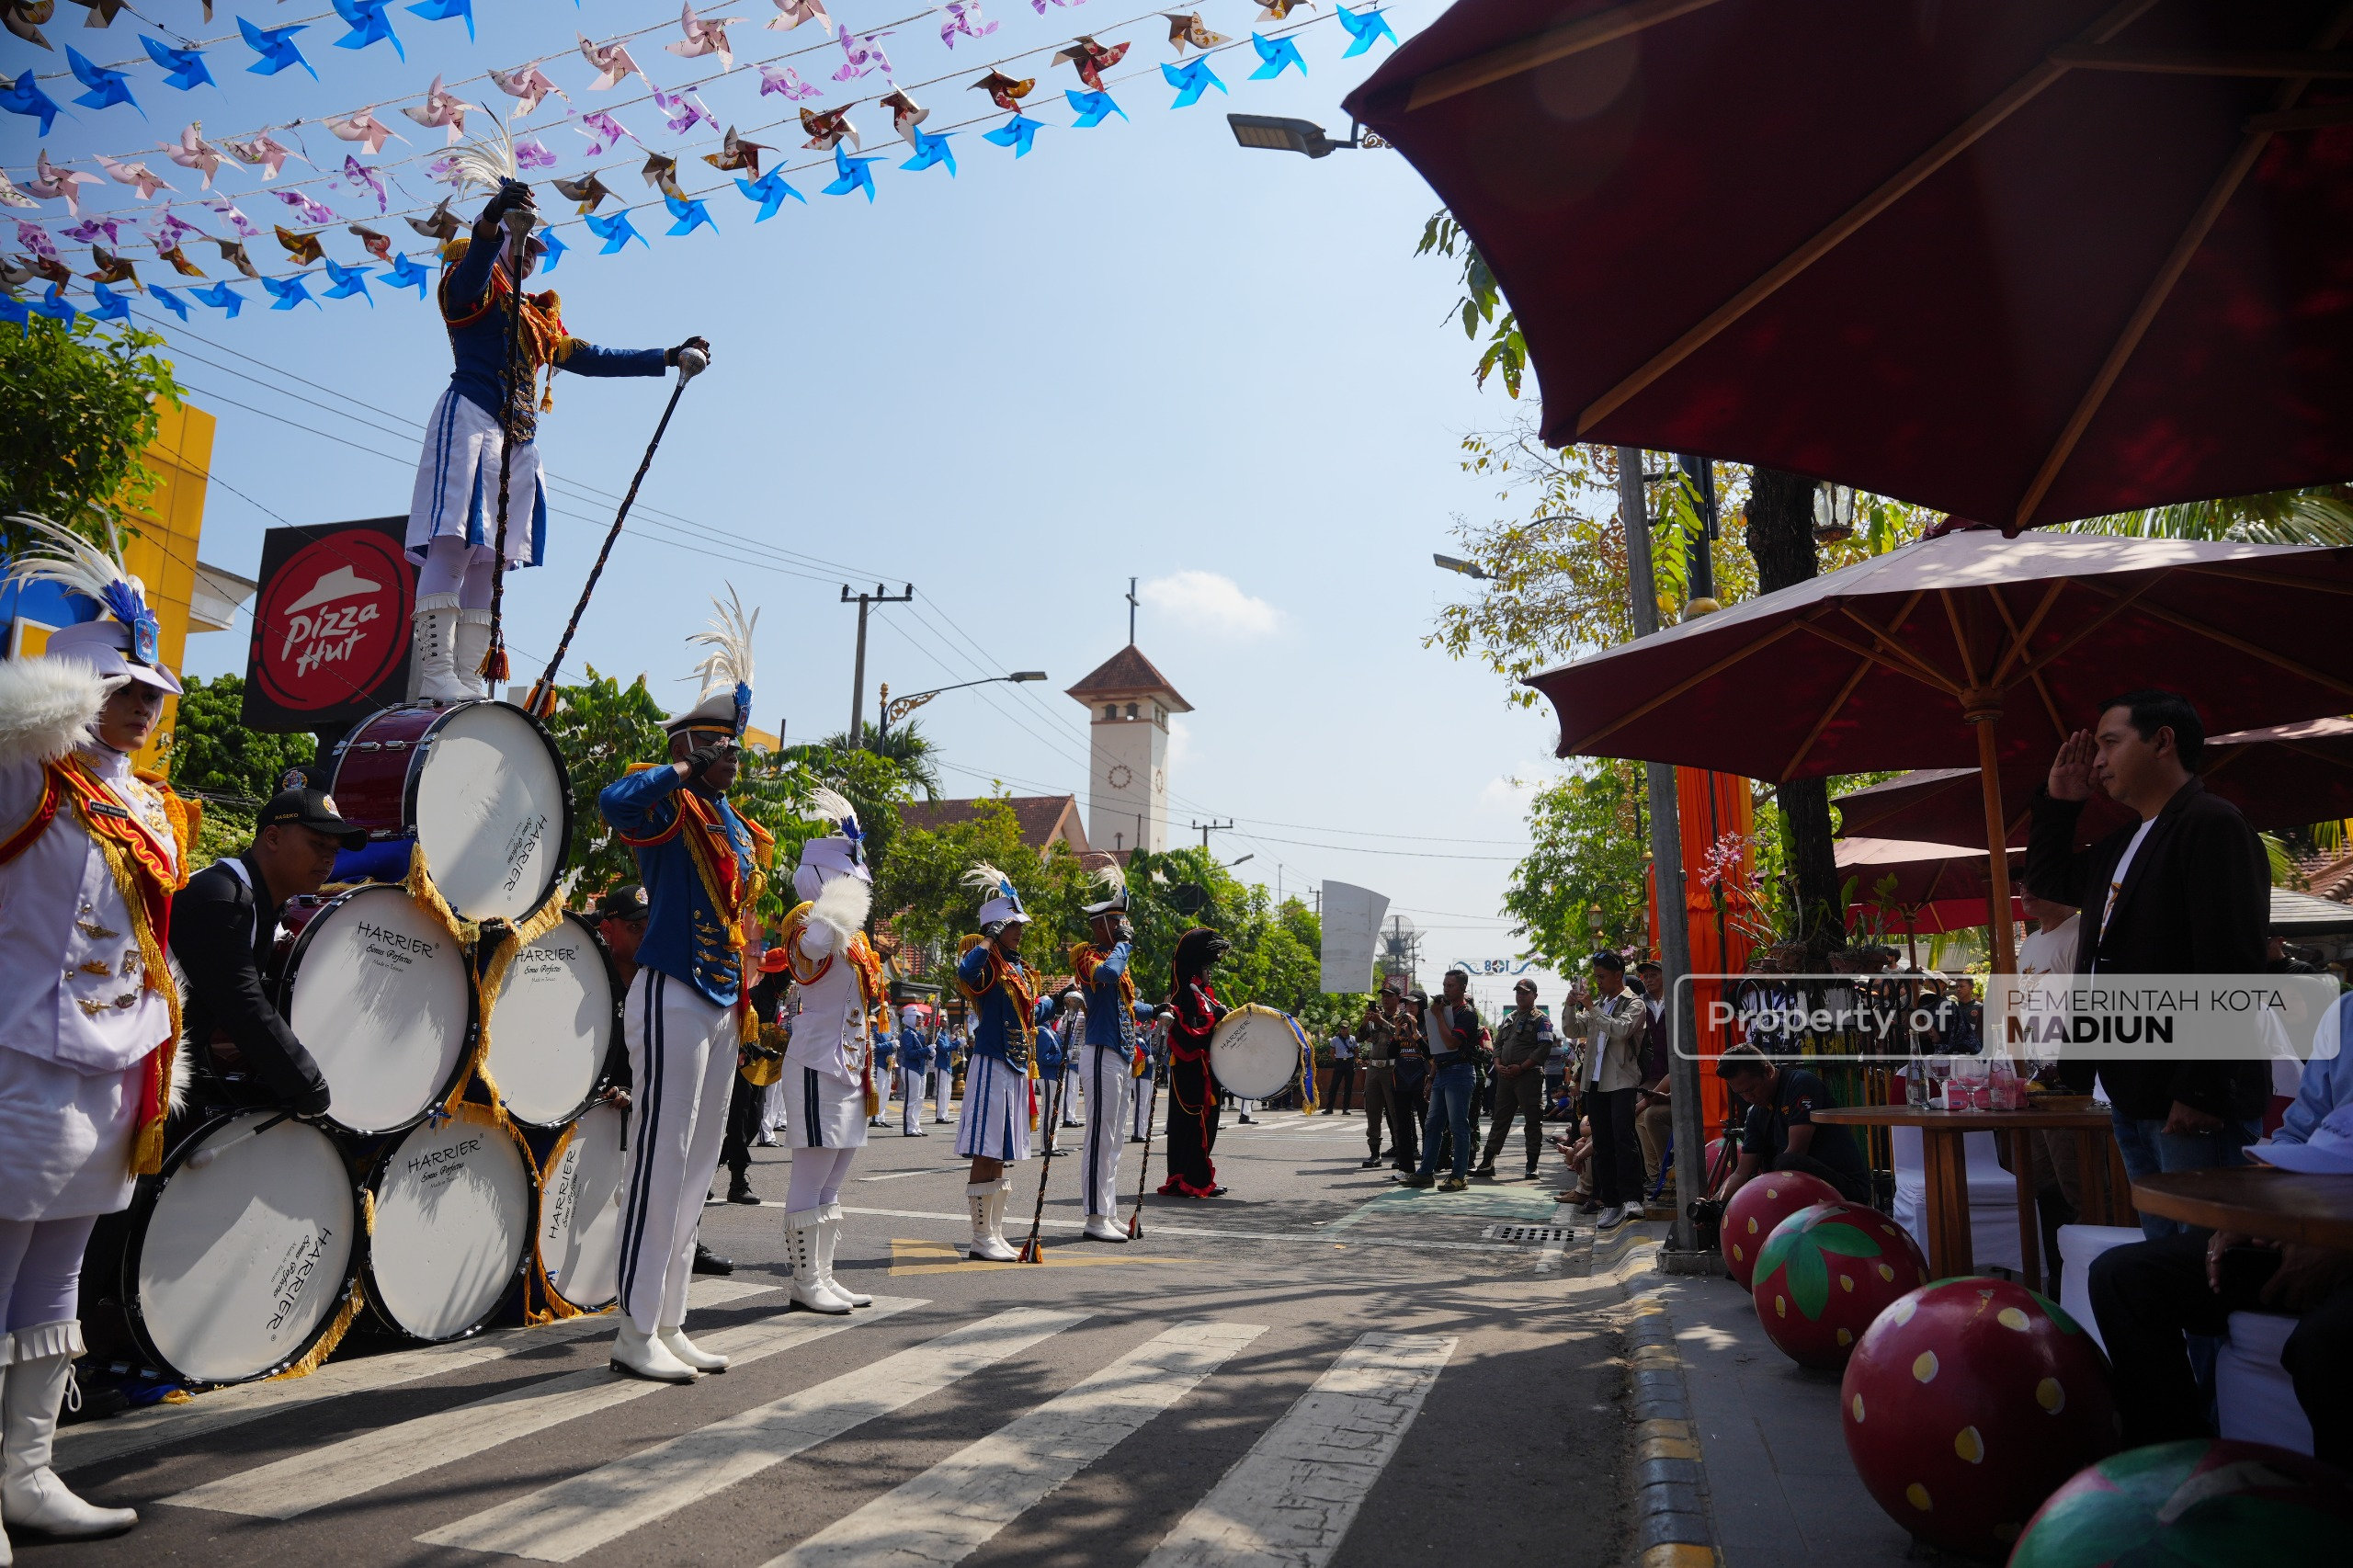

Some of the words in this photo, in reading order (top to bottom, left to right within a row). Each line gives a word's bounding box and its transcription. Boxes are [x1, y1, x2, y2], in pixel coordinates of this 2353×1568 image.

[281, 603, 381, 662] Pizza
[297, 630, 367, 677] Hut
[504, 814, 547, 891] HARRIER
[358, 921, 433, 959] HARRIER
[366, 943, 384, 956] Sonus
[515, 949, 576, 962] HARRIER
[1220, 1019, 1251, 1050] HARRIER
[408, 1140, 481, 1174] HARRIER
[548, 1149, 576, 1239] HARRIER
[295, 1234, 310, 1260] Sonus
[266, 1227, 333, 1330] HARRIER
